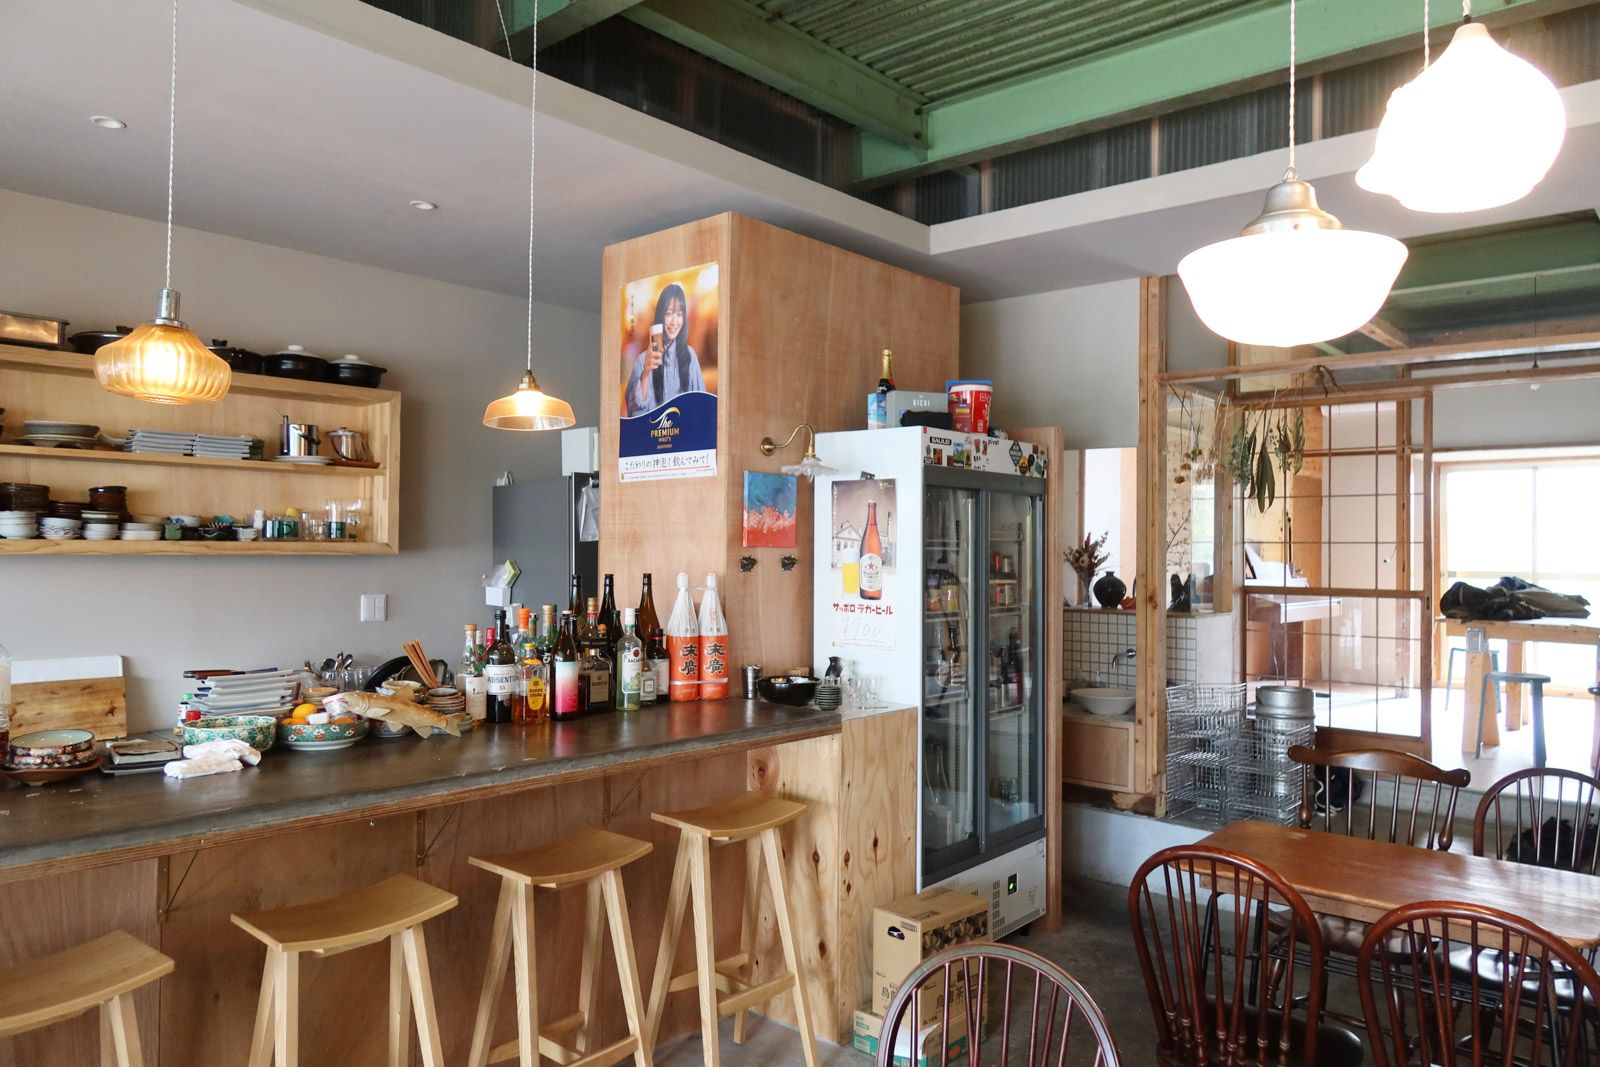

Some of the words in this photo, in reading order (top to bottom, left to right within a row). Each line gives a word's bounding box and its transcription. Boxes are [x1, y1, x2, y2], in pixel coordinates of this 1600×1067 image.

[650, 427, 680, 437] PREMIUM
[704, 642, 726, 674] 末廣
[487, 675, 513, 684] ABSENT
